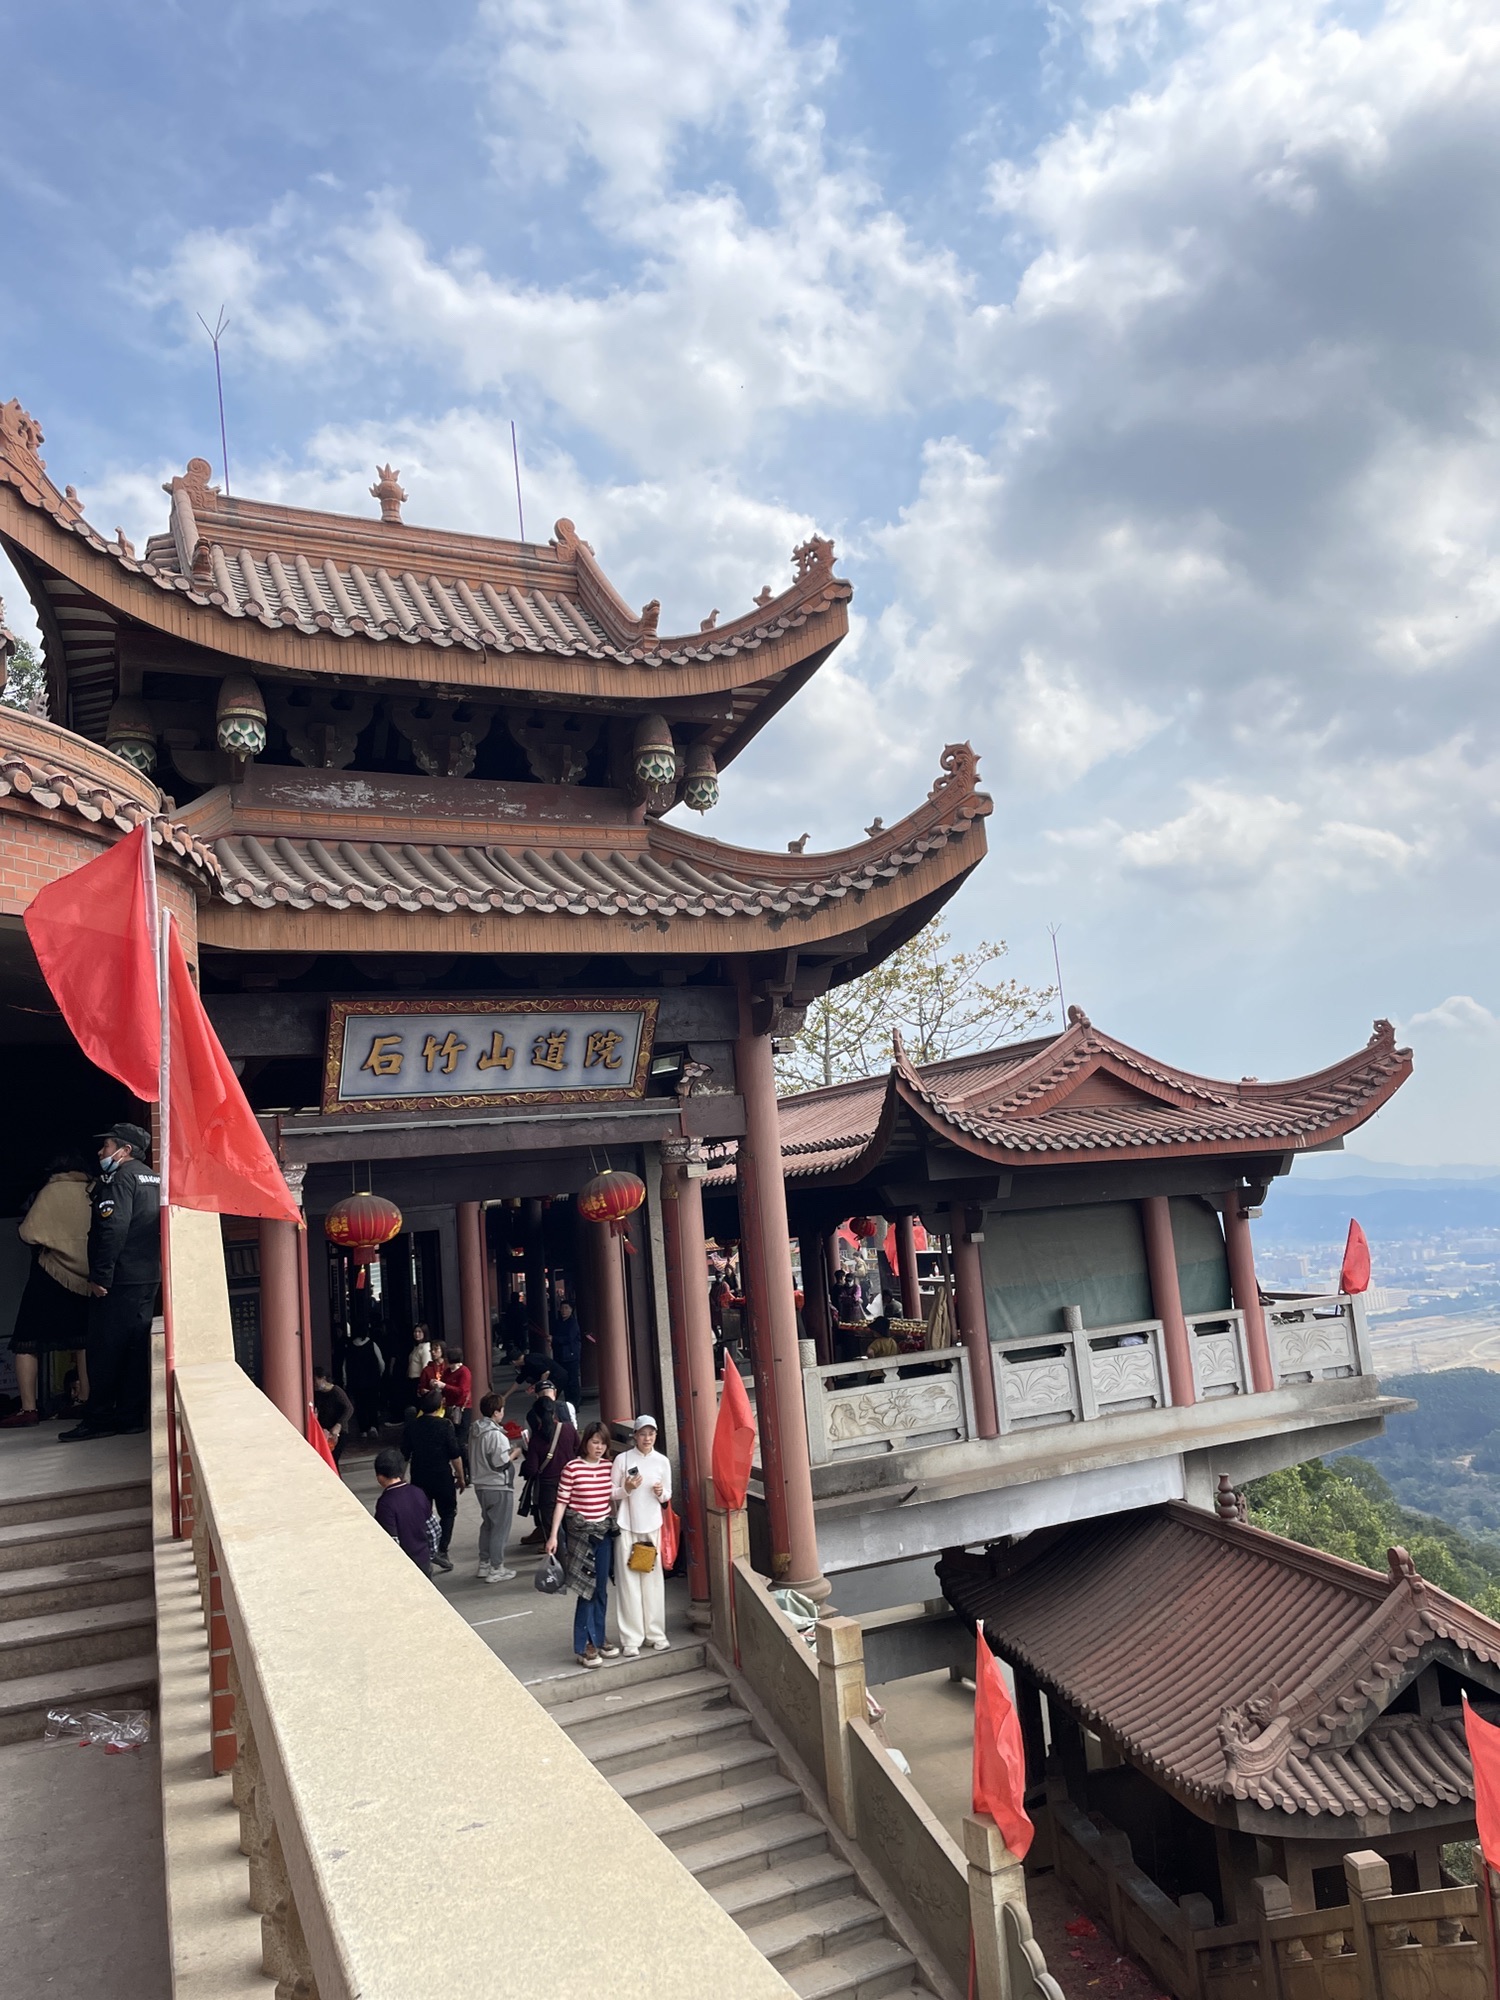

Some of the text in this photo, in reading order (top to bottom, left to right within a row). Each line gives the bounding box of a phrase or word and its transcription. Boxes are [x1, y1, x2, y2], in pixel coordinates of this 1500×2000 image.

[361, 1030, 623, 1076] 石竹山道院
